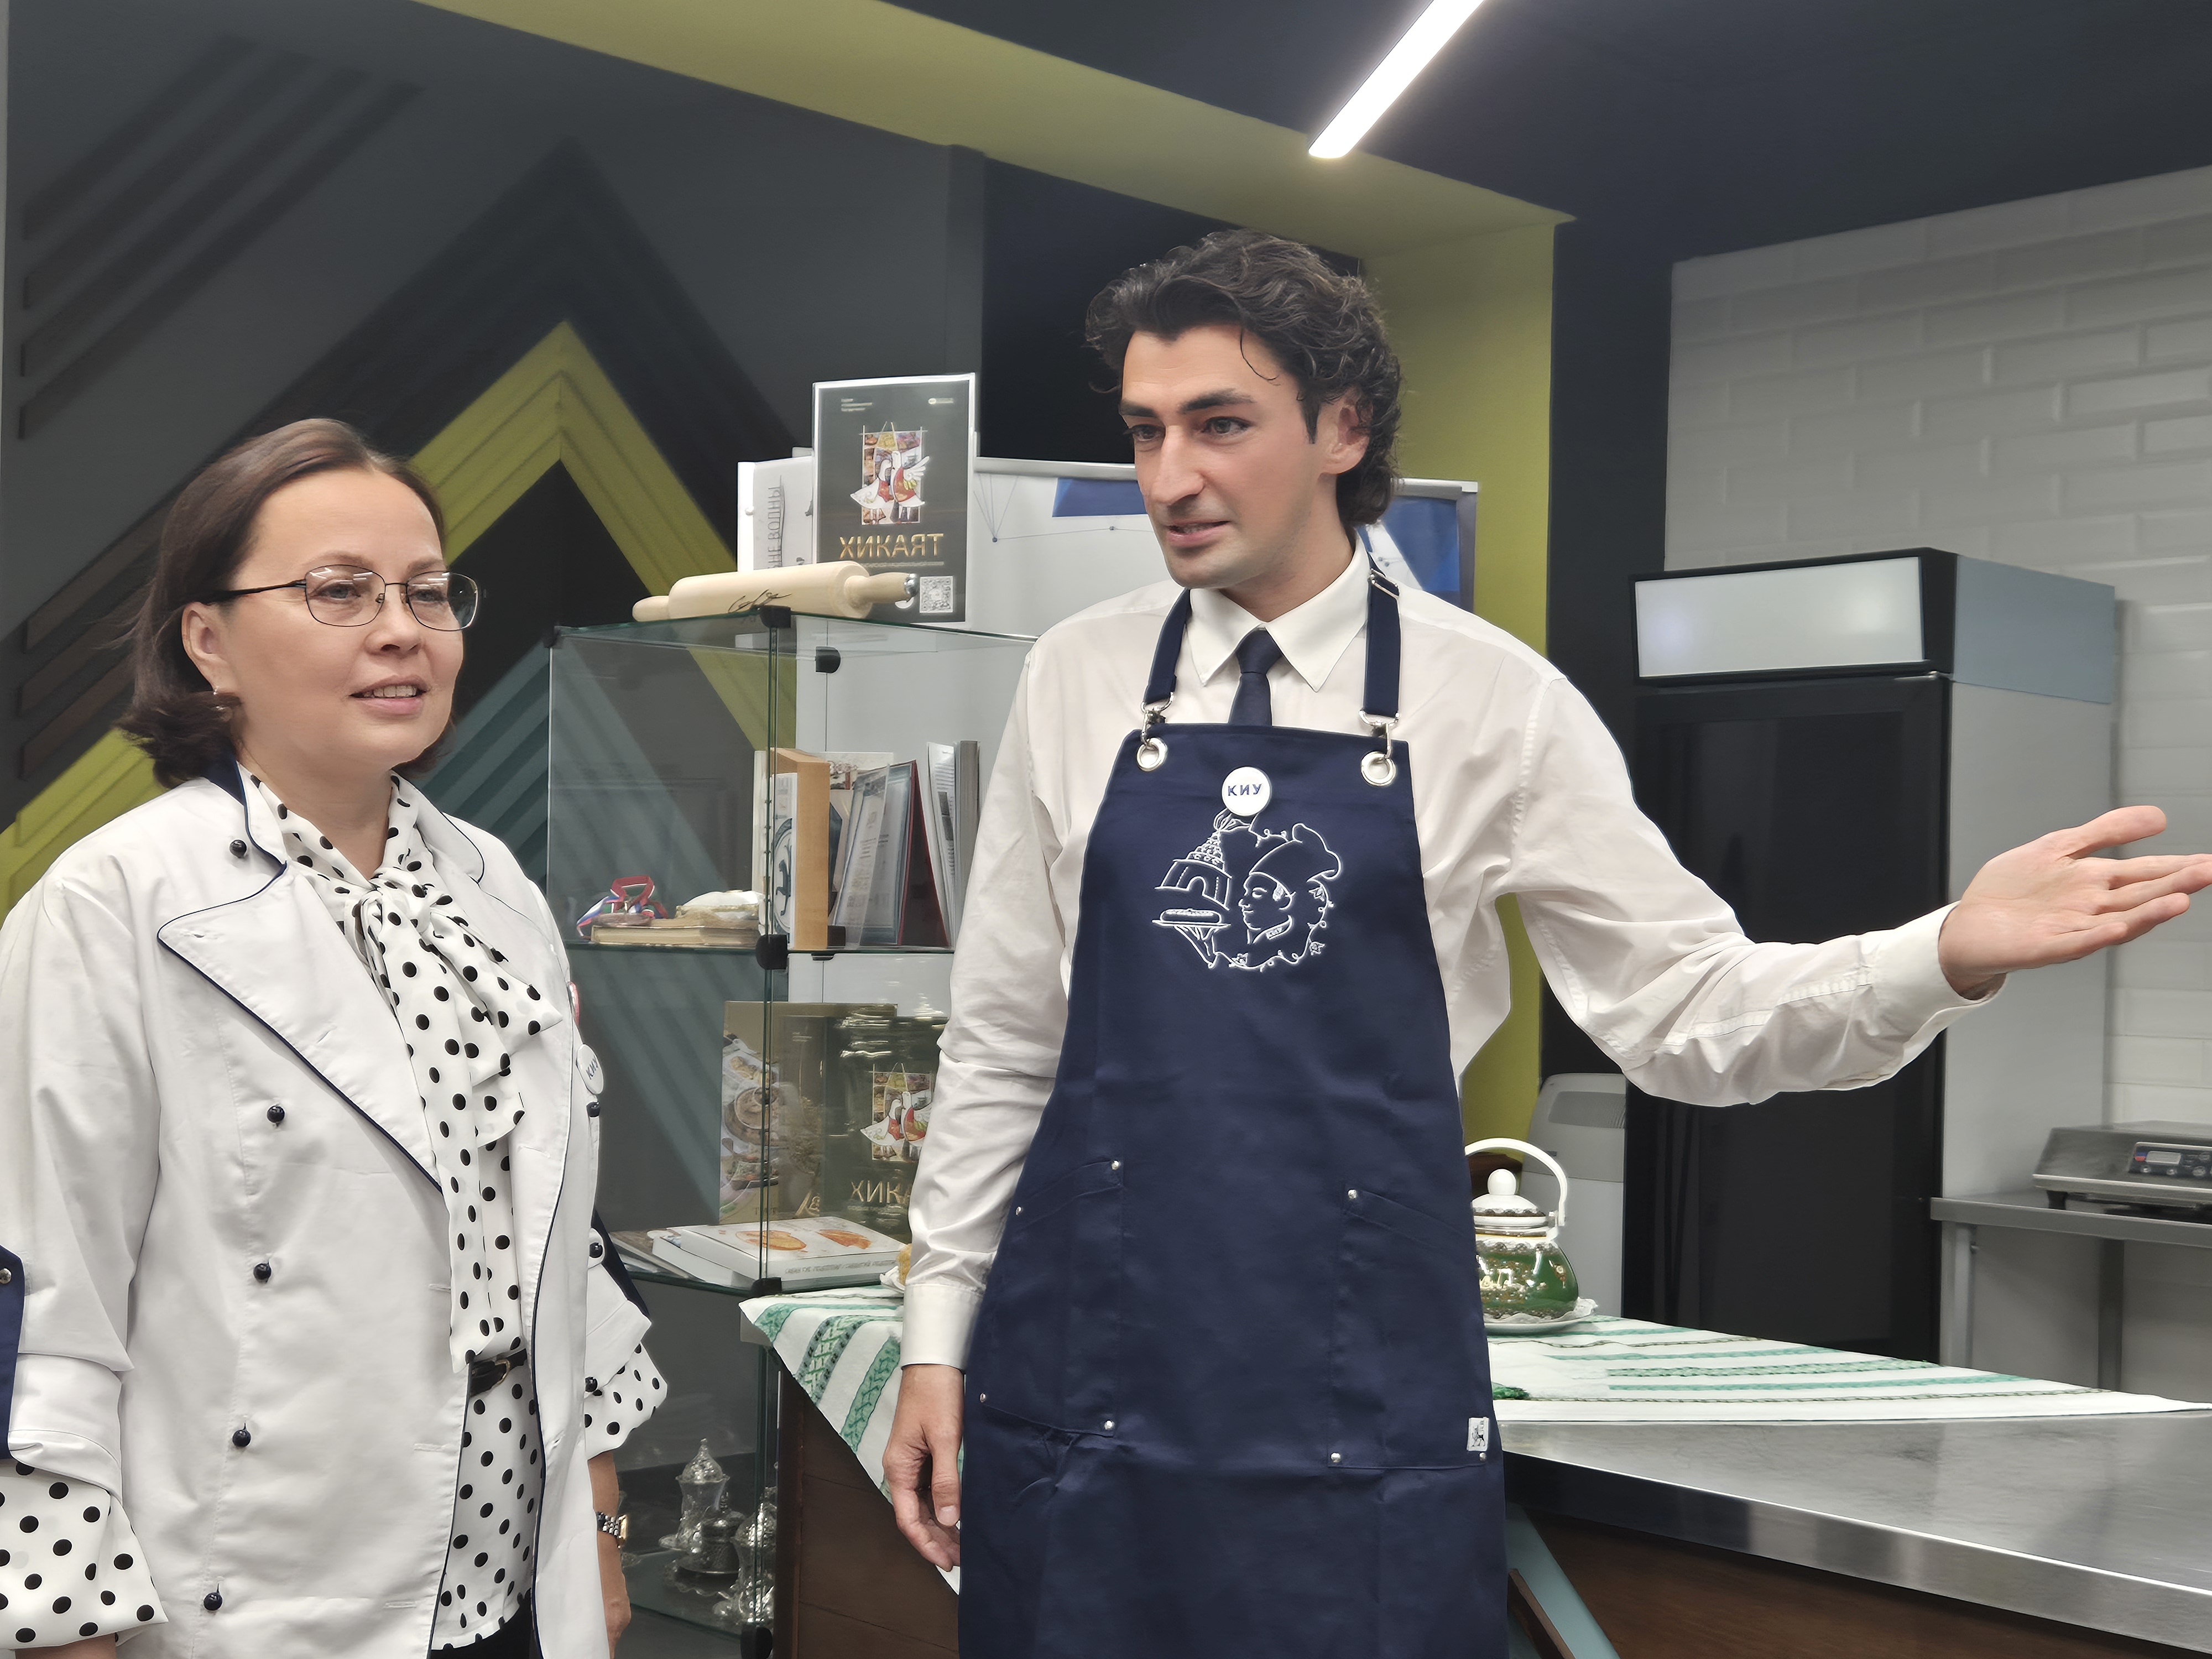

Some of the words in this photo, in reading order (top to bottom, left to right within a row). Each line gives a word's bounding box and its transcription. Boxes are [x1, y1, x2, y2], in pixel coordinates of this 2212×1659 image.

[839, 533, 944, 559] ХИКАЯТ
[1228, 784, 1262, 796] КИУ
[586, 1054, 598, 1080] КИУ
